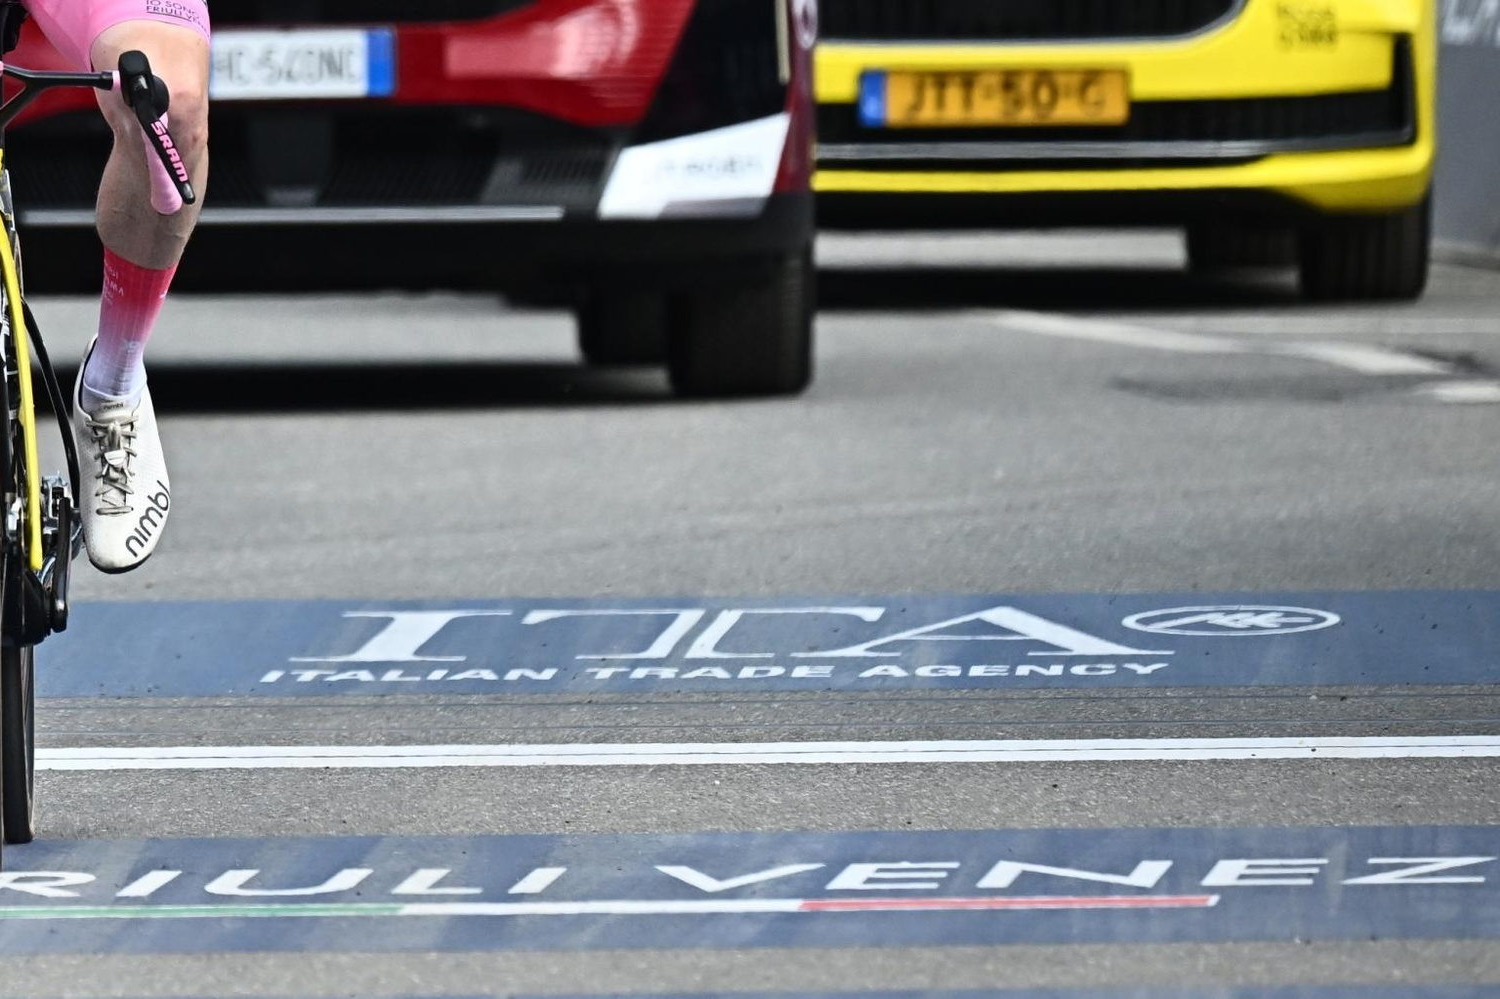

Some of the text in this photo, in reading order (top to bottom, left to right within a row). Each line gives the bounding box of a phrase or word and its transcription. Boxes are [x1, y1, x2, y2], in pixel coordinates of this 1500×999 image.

[146, 6, 182, 16] FRIULI
[150, 120, 191, 182] SRAM
[126, 480, 170, 558] nimbl
[289, 605, 1175, 662] ITA
[258, 662, 1171, 682] ITALIAN TRADE AGENCY
[651, 854, 1499, 893] VENEZ
